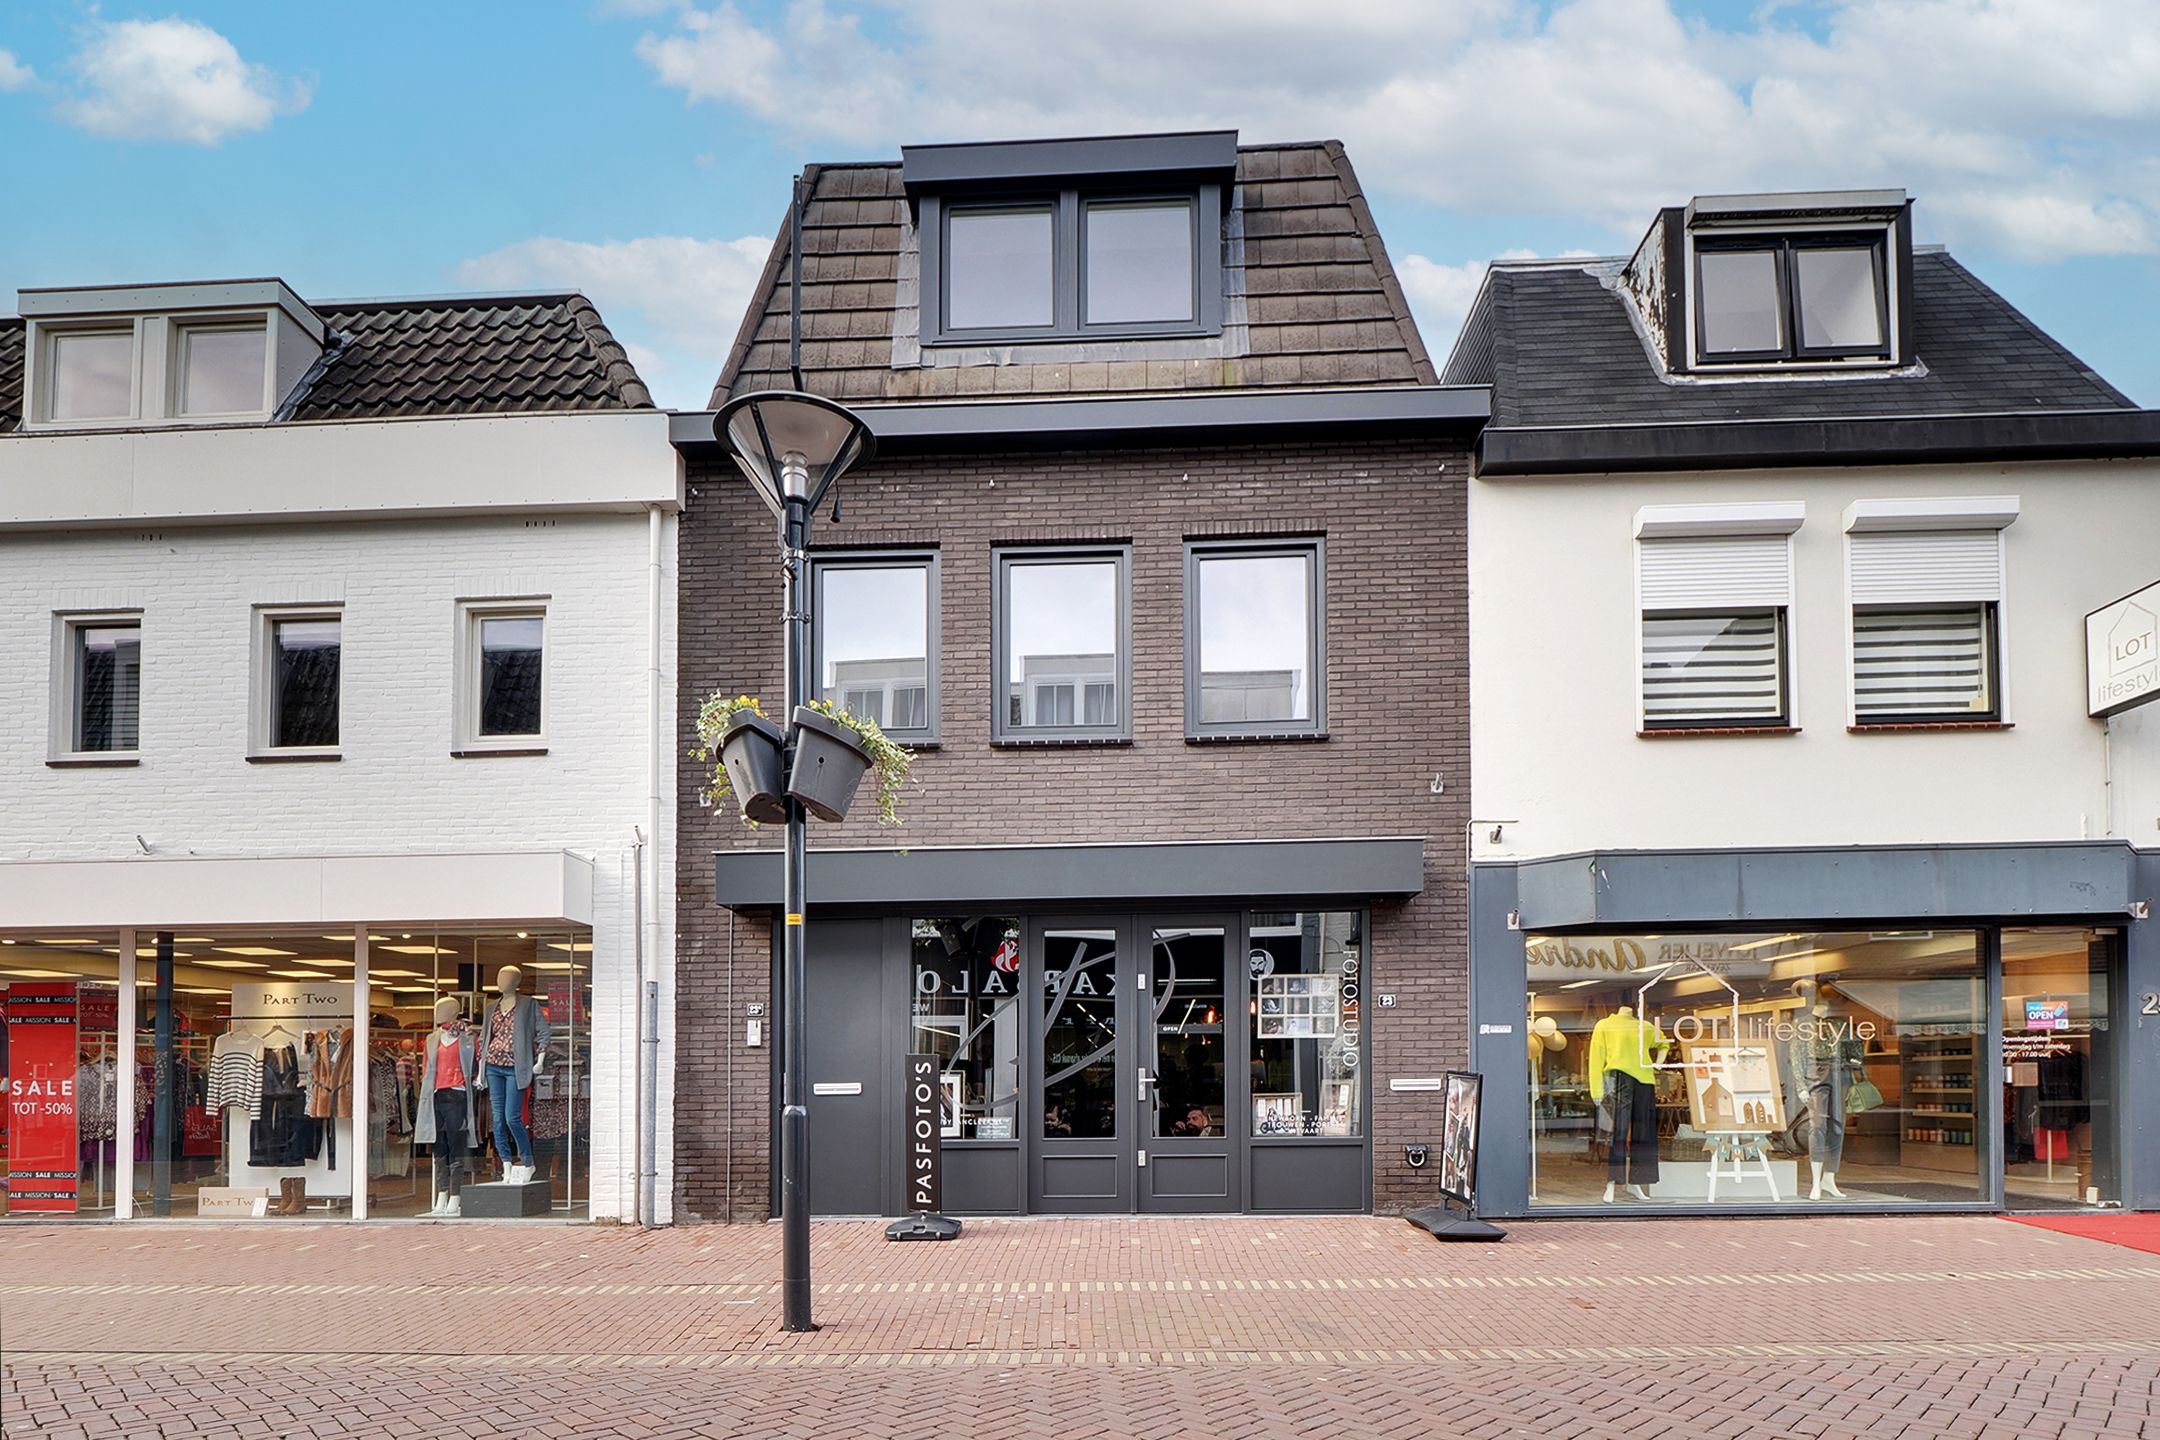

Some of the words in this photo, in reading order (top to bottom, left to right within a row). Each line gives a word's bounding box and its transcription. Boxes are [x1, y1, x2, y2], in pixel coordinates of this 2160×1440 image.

[2115, 632, 2152, 661] LOT
[2098, 665, 2160, 703] lifestyl
[263, 994, 299, 1005] PART
[303, 993, 338, 1004] TWO
[1342, 950, 1359, 1067] FOTOSTUDIO
[2029, 1010, 2053, 1020] OPEN
[1654, 1015, 1727, 1043] LOT
[1749, 1015, 1876, 1047] lifestyle
[12, 1080, 72, 1096] SALE
[12, 1103, 37, 1115] TOT
[40, 1102, 73, 1115] -50%
[915, 1061, 932, 1204] PASFOTO'S
[202, 1197, 231, 1206] PART
[233, 1197, 254, 1206] TW
